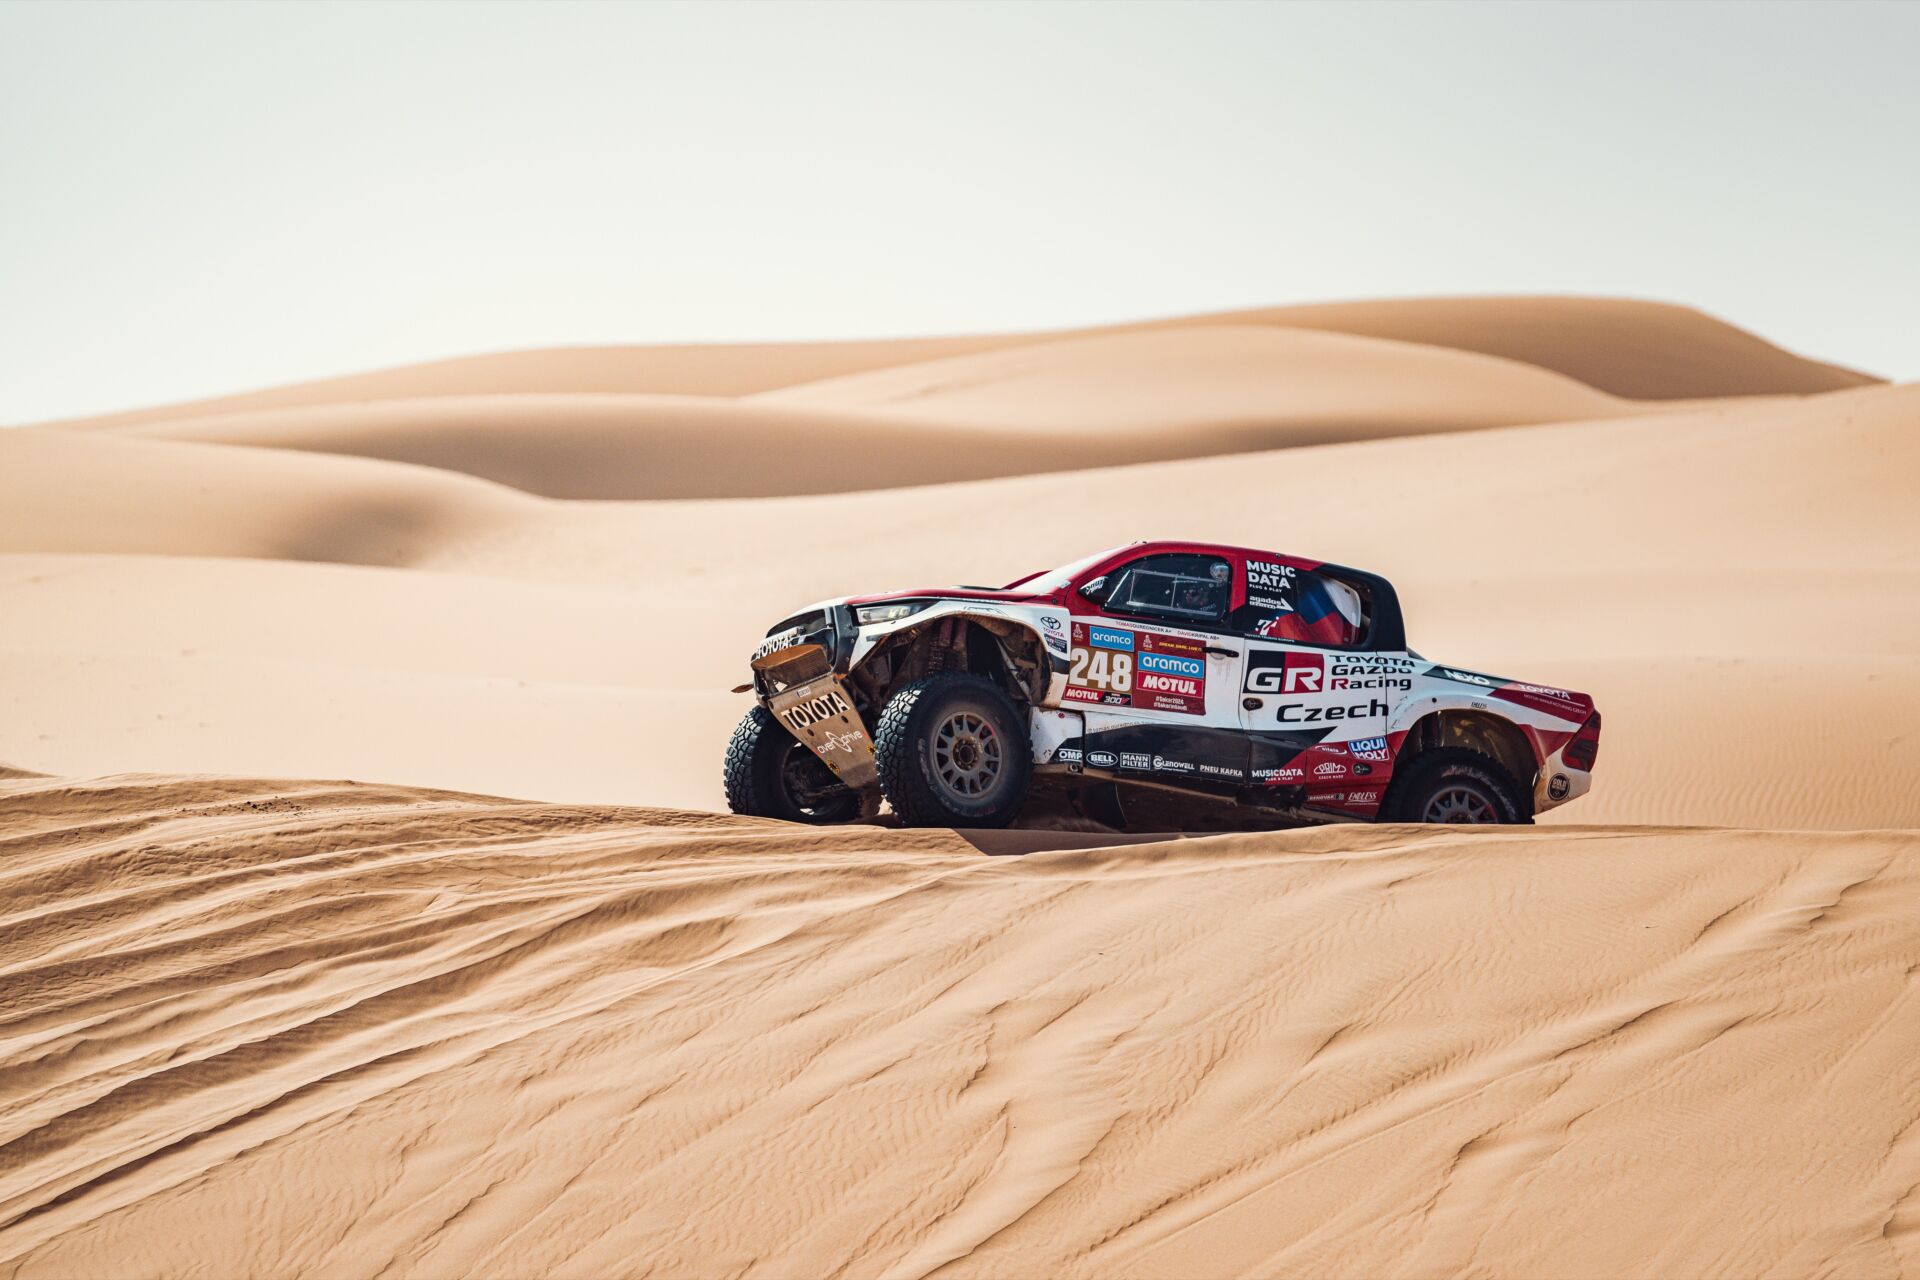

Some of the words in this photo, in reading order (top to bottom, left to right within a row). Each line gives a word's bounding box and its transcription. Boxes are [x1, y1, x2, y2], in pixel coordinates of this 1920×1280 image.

[1246, 560, 1296, 578] MUSIC
[1248, 572, 1291, 589] DATA
[1092, 631, 1131, 645] aramco
[1142, 653, 1200, 674] aramco
[1329, 655, 1416, 668] TOYOTA
[1069, 647, 1132, 692] 248
[1331, 664, 1412, 676] GAZOO
[1142, 675, 1197, 695] MOTUL
[1246, 667, 1322, 692] GR
[1331, 676, 1412, 691] Racing
[1066, 688, 1099, 700] MOTUL
[1519, 683, 1571, 700] TOYOTA
[781, 691, 850, 730] TOYOTA
[1276, 699, 1389, 723] Czech
[1350, 738, 1385, 752] LIQUI
[1059, 750, 1082, 760] OMP
[1091, 754, 1114, 762] BELL
[1122, 754, 1148, 762] MANN
[1354, 749, 1388, 760] MOLY
[1122, 760, 1148, 768] FILTER
[1200, 764, 1219, 774] PNEU
[1220, 767, 1243, 777] KAFKA
[1319, 763, 1341, 773] PRIM
[1252, 768, 1304, 778] MUSICDATA
[1348, 792, 1377, 801] ENDLESS
